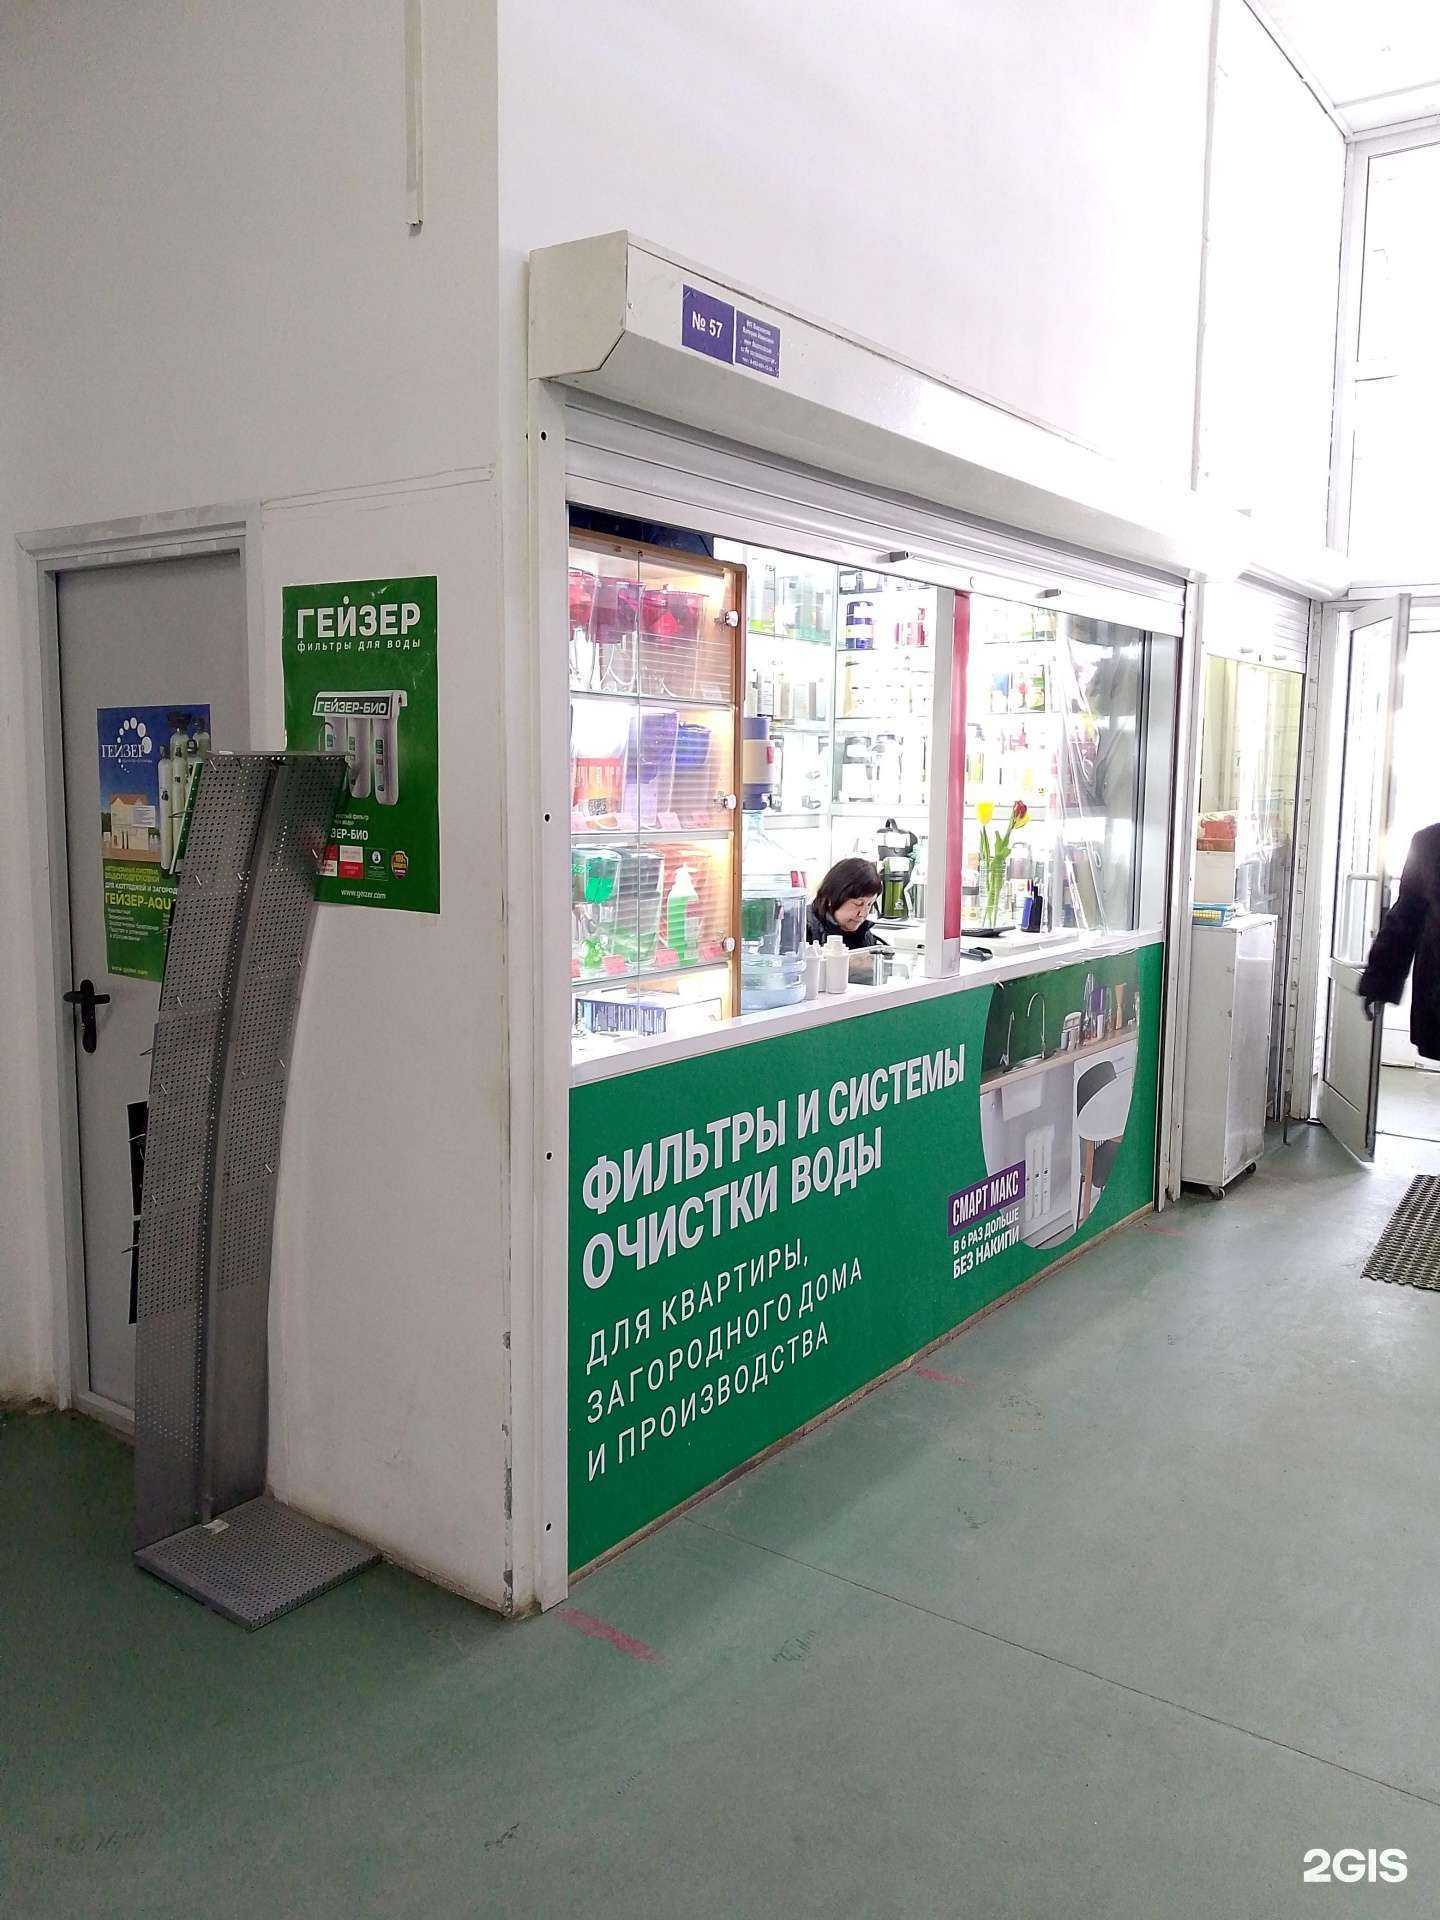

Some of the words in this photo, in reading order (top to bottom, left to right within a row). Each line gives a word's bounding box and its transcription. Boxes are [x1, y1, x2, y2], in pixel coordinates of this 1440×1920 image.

[692, 311, 706, 332] №
[709, 318, 723, 338] 57
[297, 595, 421, 639] ГЕЙЗЕР
[297, 641, 352, 654] фильтры
[358, 641, 380, 651] для
[387, 638, 421, 649] воды
[315, 698, 387, 714] ГЕЙЗЕР-БИО
[330, 827, 369, 841] ЗЕР-БИО
[104, 890, 172, 910] ГЕЙЗЕР-AQU
[582, 1100, 786, 1214] ФИЛЬТРЫ
[798, 1089, 819, 1139] И
[828, 1044, 965, 1126] СИСТЕМЫ
[583, 1166, 778, 1290] ОЧИСТКИ
[791, 1126, 882, 1205] ВОДЫ
[952, 1184, 988, 1226] СМАРТ
[990, 1170, 1019, 1207] МАКС
[953, 1240, 959, 1255] В
[961, 1235, 966, 1250] 6
[968, 1226, 983, 1247] РАЗ
[984, 1207, 1019, 1240] ДОЛЬШЕ
[953, 1251, 973, 1279] БЕЗ
[975, 1225, 1020, 1266] НАКИПИ
[586, 1308, 650, 1375] ДЛЯ
[662, 1238, 808, 1330] КВАРТИРЫ,
[587, 1293, 791, 1424] ЗАГОРОДНОГО
[799, 1257, 862, 1319] ДОМА
[588, 1443, 605, 1482] И
[618, 1321, 829, 1463] ПРОИЗВОДСТВА
